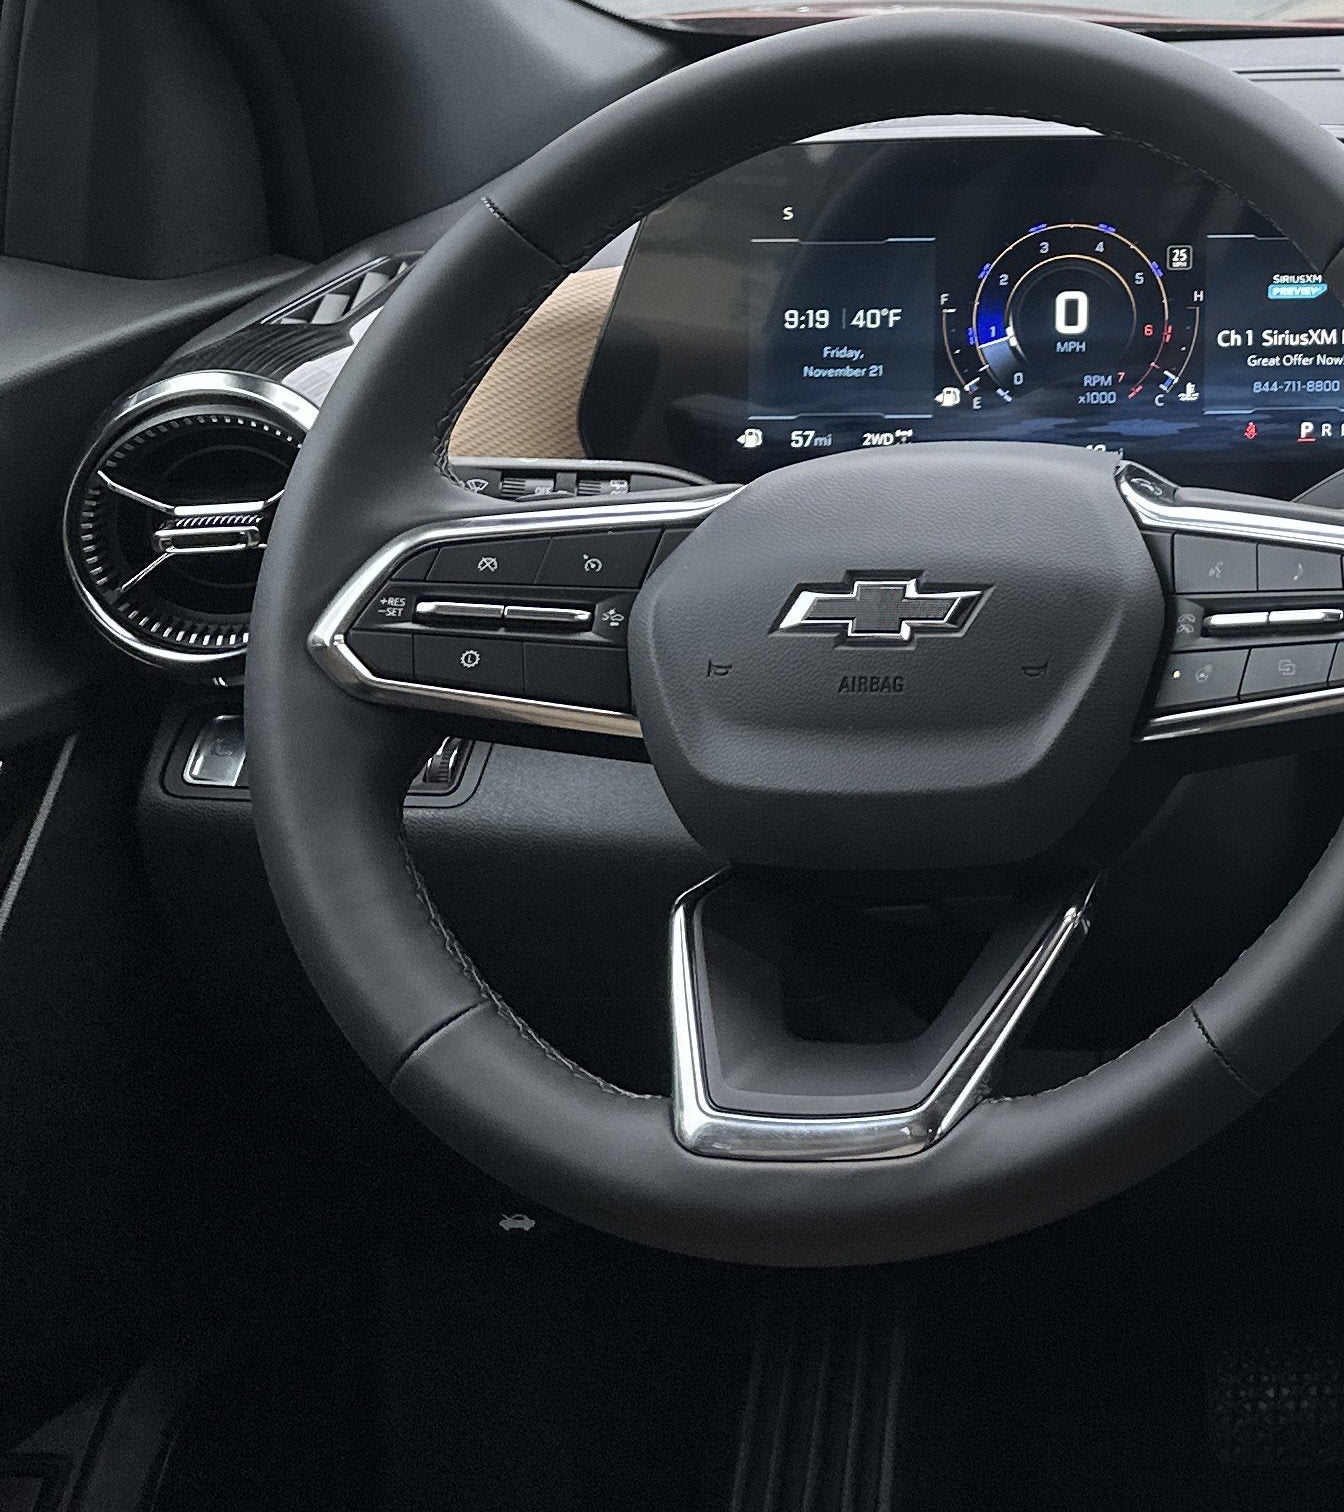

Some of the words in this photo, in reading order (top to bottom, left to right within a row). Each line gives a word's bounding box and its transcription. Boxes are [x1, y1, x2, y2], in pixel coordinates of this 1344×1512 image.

[783, 206, 794, 221] S
[1039, 241, 1050, 254] 3
[1094, 241, 1105, 253] 4
[1171, 248, 1187, 261] 25
[999, 274, 1009, 286] 2
[1134, 273, 1145, 285] 5
[1273, 274, 1322, 284] SIRIUSXM
[941, 294, 950, 306] F
[1194, 290, 1204, 302] H
[850, 308, 902, 328] 40°F
[1055, 290, 1088, 334] 0
[784, 309, 830, 329] 9:19
[989, 325, 996, 337] 1
[1144, 324, 1153, 336] 6
[1217, 329, 1242, 347] Ch
[1245, 330, 1253, 346] 1
[1261, 329, 1337, 347] SiriusXM
[823, 346, 864, 361] Friday,
[1056, 341, 1086, 353] MPH
[1247, 354, 1280, 367] Great
[1282, 354, 1314, 366] Offer
[803, 364, 867, 378] November
[868, 364, 883, 377] 21
[1117, 372, 1126, 383] 7
[1013, 372, 1023, 385] 0
[1084, 375, 1112, 387] RPM
[1253, 380, 1340, 393] 844-711-8800
[973, 397, 982, 409] E
[1078, 392, 1116, 404] x1000
[1155, 394, 1165, 406] C
[1300, 422, 1314, 438] P
[1321, 423, 1332, 436] R
[862, 433, 894, 446] 2WD
[839, 675, 904, 693] AIRBAG
